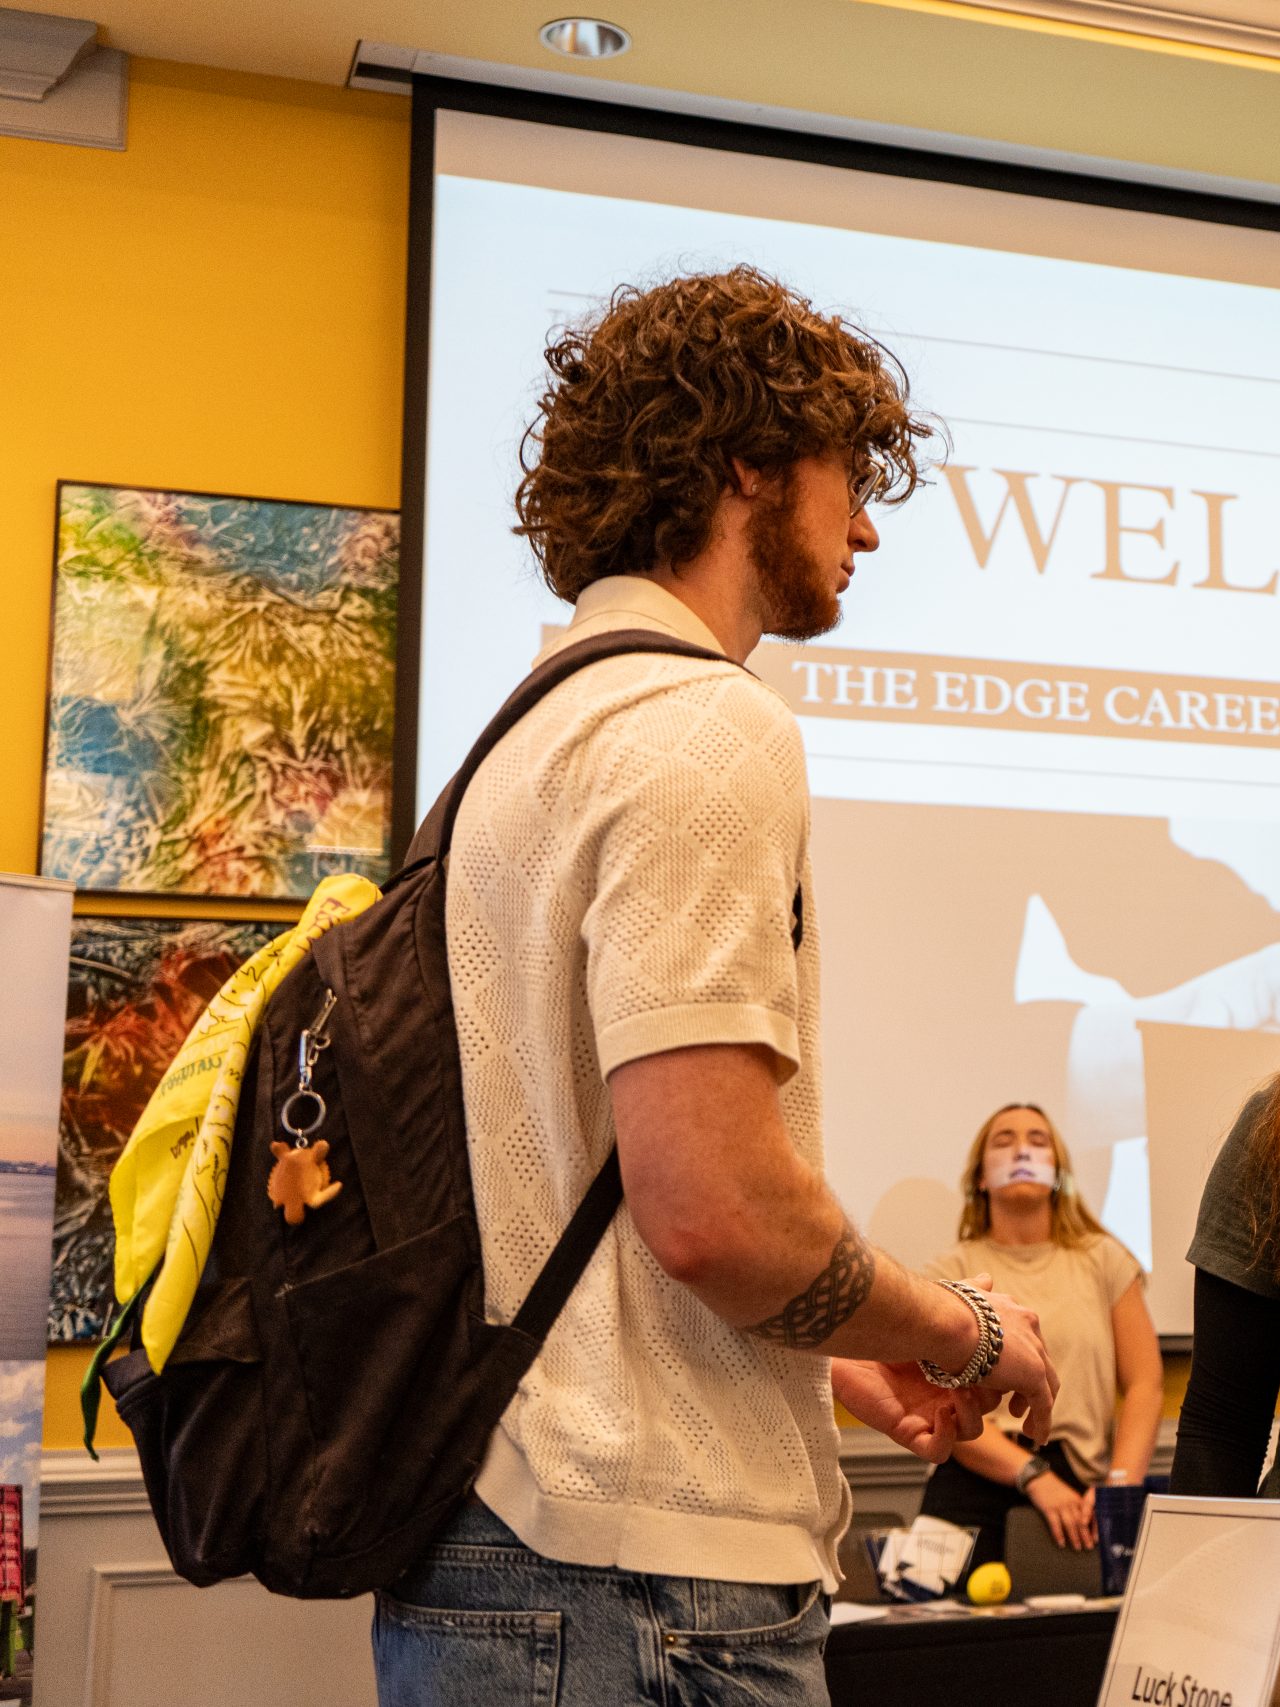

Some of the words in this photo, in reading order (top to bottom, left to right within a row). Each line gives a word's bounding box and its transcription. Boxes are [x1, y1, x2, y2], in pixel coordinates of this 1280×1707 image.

[791, 660, 918, 709] THE
[931, 671, 1091, 722] EDGE
[1132, 1666, 1177, 1707] Luck
